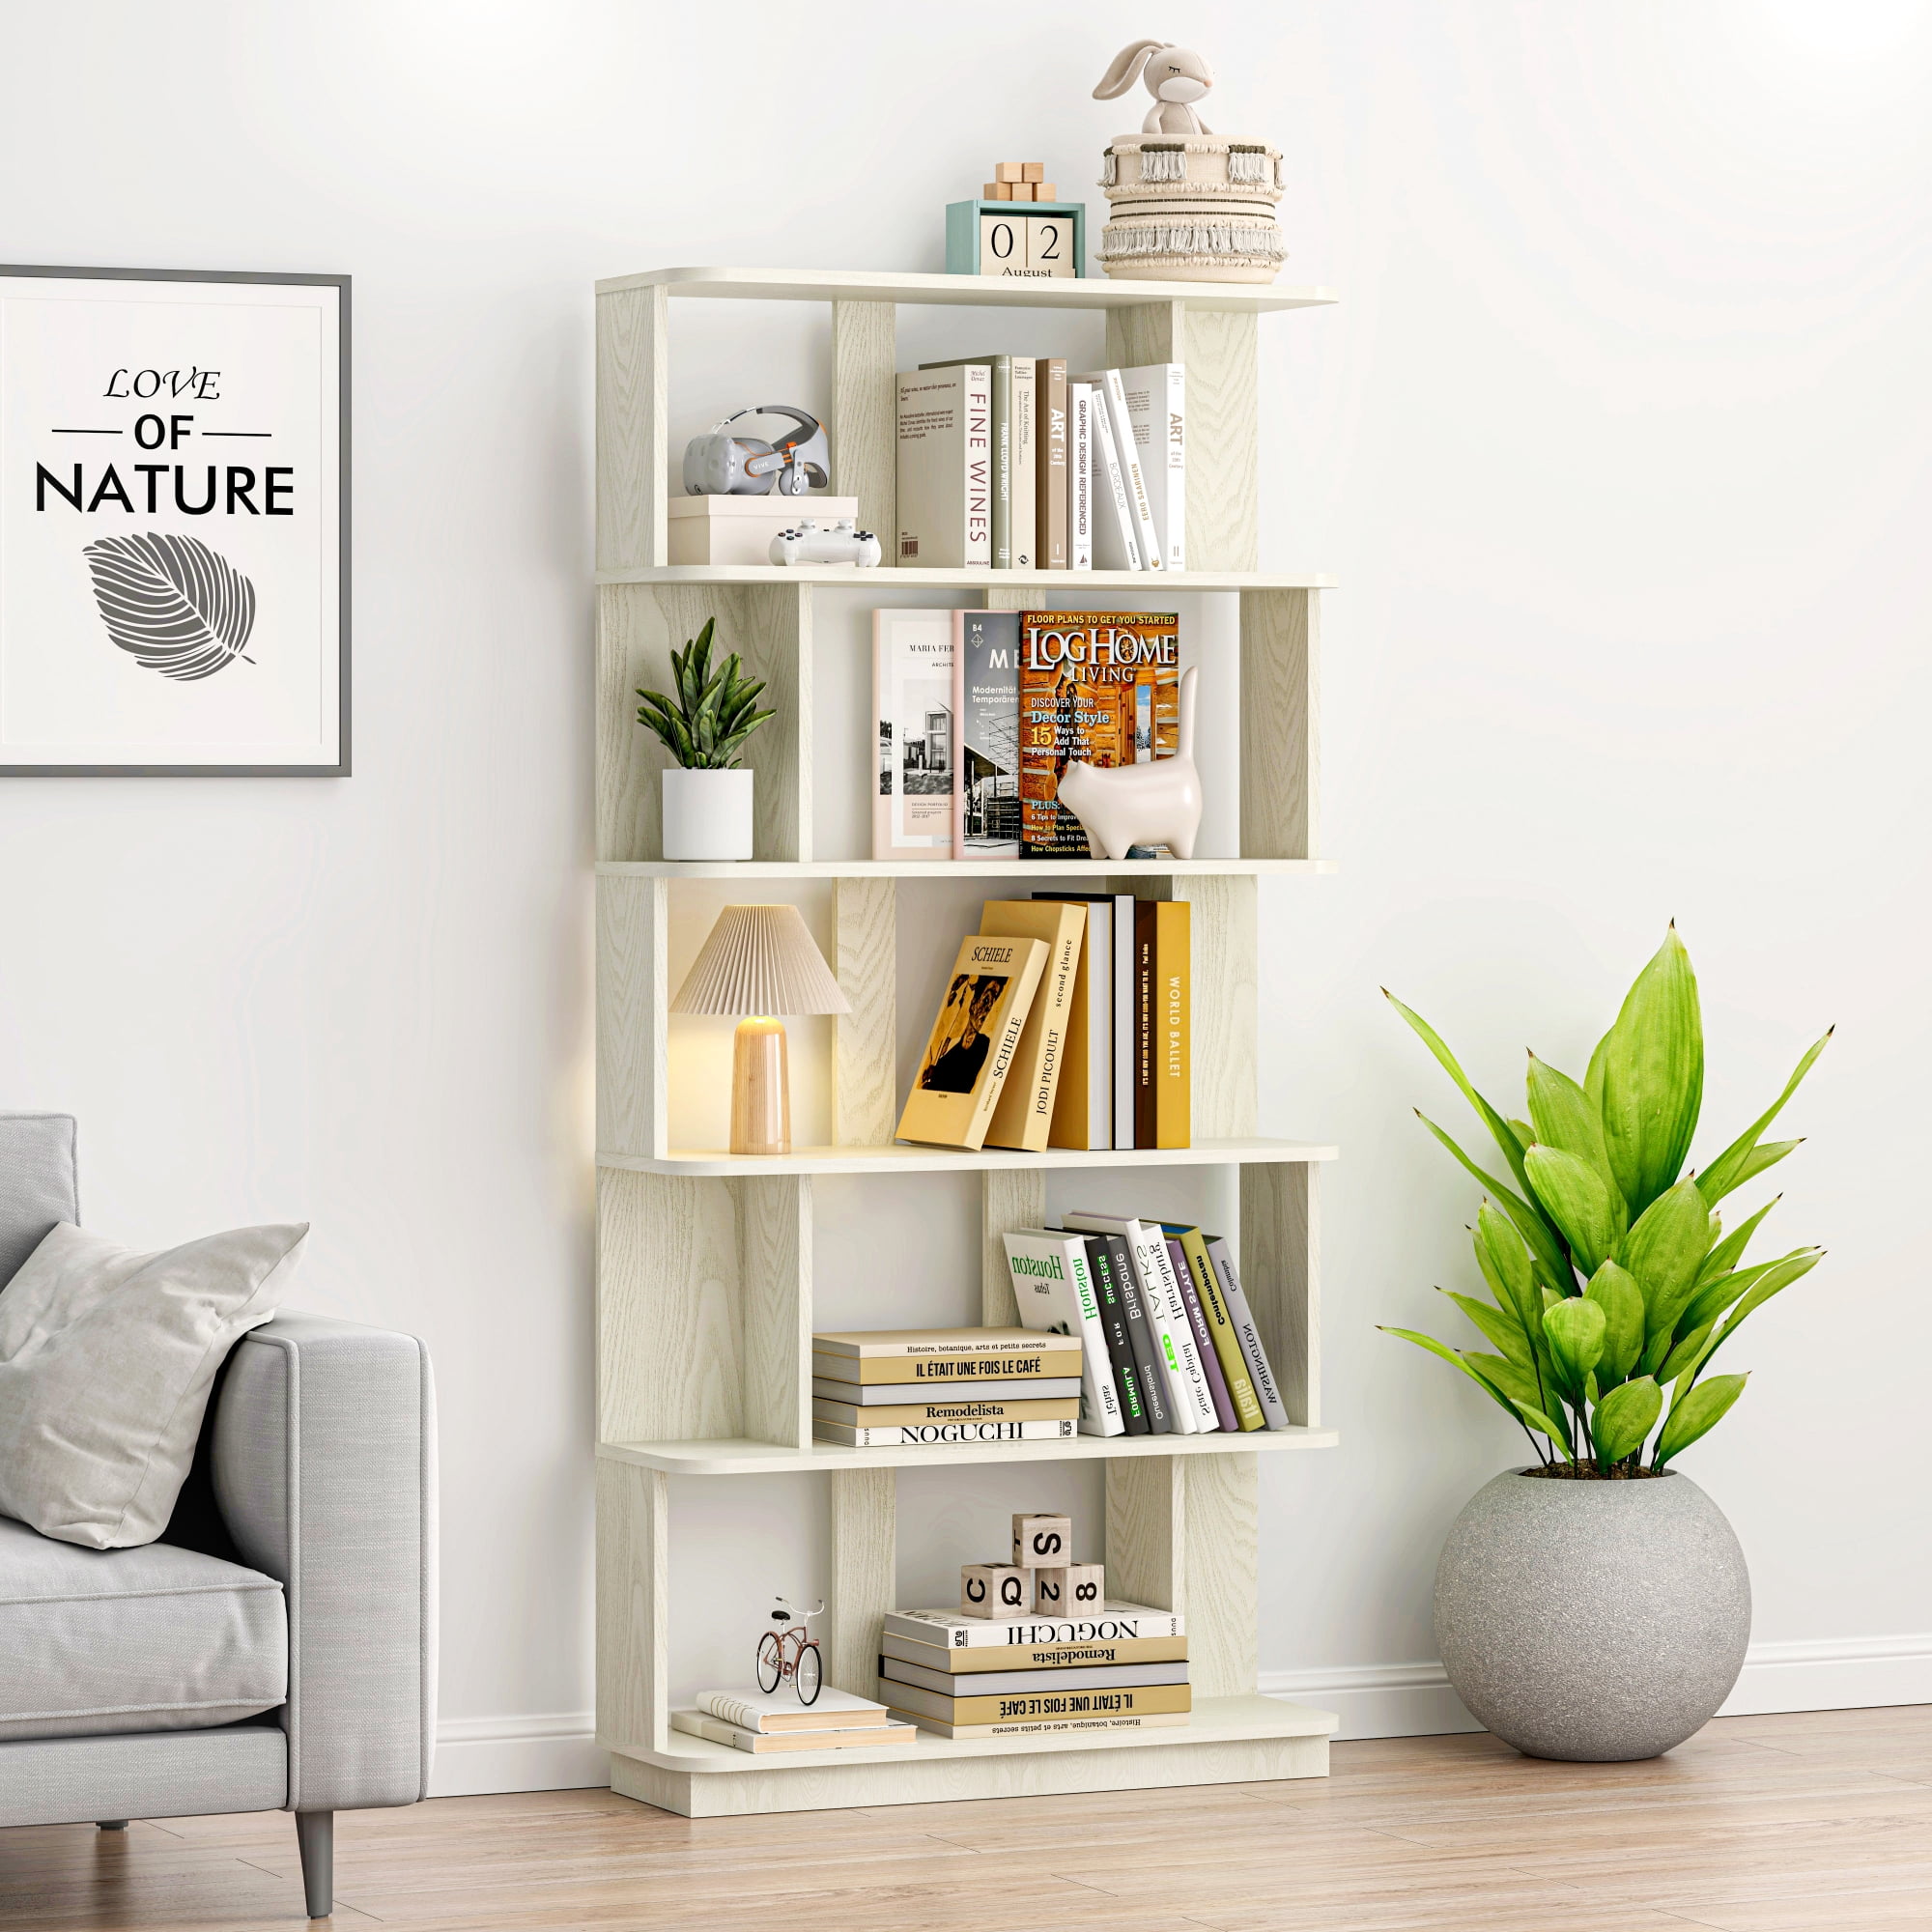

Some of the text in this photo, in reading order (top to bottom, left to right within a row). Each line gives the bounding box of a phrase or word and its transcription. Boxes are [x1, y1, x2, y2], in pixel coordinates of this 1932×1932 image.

[1002, 267, 1052, 277] August
[103, 366, 220, 400] LOVE
[134, 413, 194, 450] OF
[970, 393, 986, 448] FINE
[1050, 408, 1065, 442] ART
[1170, 412, 1182, 445] ART
[36, 461, 294, 515] NATURE
[1110, 462, 1126, 509] BORDEAUX
[1131, 464, 1150, 521] EERO SAARINEN
[969, 460, 986, 543] WINES
[1027, 614, 1054, 623] FLOOR
[1057, 614, 1084, 624] PLANS
[1100, 615, 1116, 624] GET
[1120, 615, 1135, 624] YOU
[1139, 615, 1176, 625] STARTED
[972, 685, 1016, 694] Modernität
[1031, 697, 1094, 707] DISCOVER YOUR
[1031, 711, 1109, 726] Decor Style
[1031, 726, 1052, 745] 15
[1054, 726, 1074, 735] Ways
[1031, 748, 1092, 756] Personal Touch
[1031, 801, 1061, 810] PLUS:
[971, 947, 1012, 963] SCHIELE
[1056, 939, 1072, 1008] second glance
[1169, 976, 1180, 1078] WORLD BALLET
[993, 1017, 1022, 1078] SCHIELE
[1036, 1029, 1059, 1115] JODI PICOULT
[917, 1356, 1041, 1377] IL ÉTAIT UNE FOIS LE CAFÉ
[925, 1404, 1004, 1419] Remodelista
[900, 1421, 1024, 1444] NOGUCHI
[1033, 1532, 1062, 1555] S
[1001, 1577, 1022, 1606] Q
[1040, 1580, 1060, 1601] 2
[1075, 1581, 1097, 1601] 8
[1007, 1620, 1139, 1645] NOGUCHI
[1033, 1649, 1115, 1662] Remodelista
[1000, 1693, 1133, 1719] IL ÉTAIT UNE FOIS LE CAFÉ
[1071, 1720, 1108, 1729] botanique,
